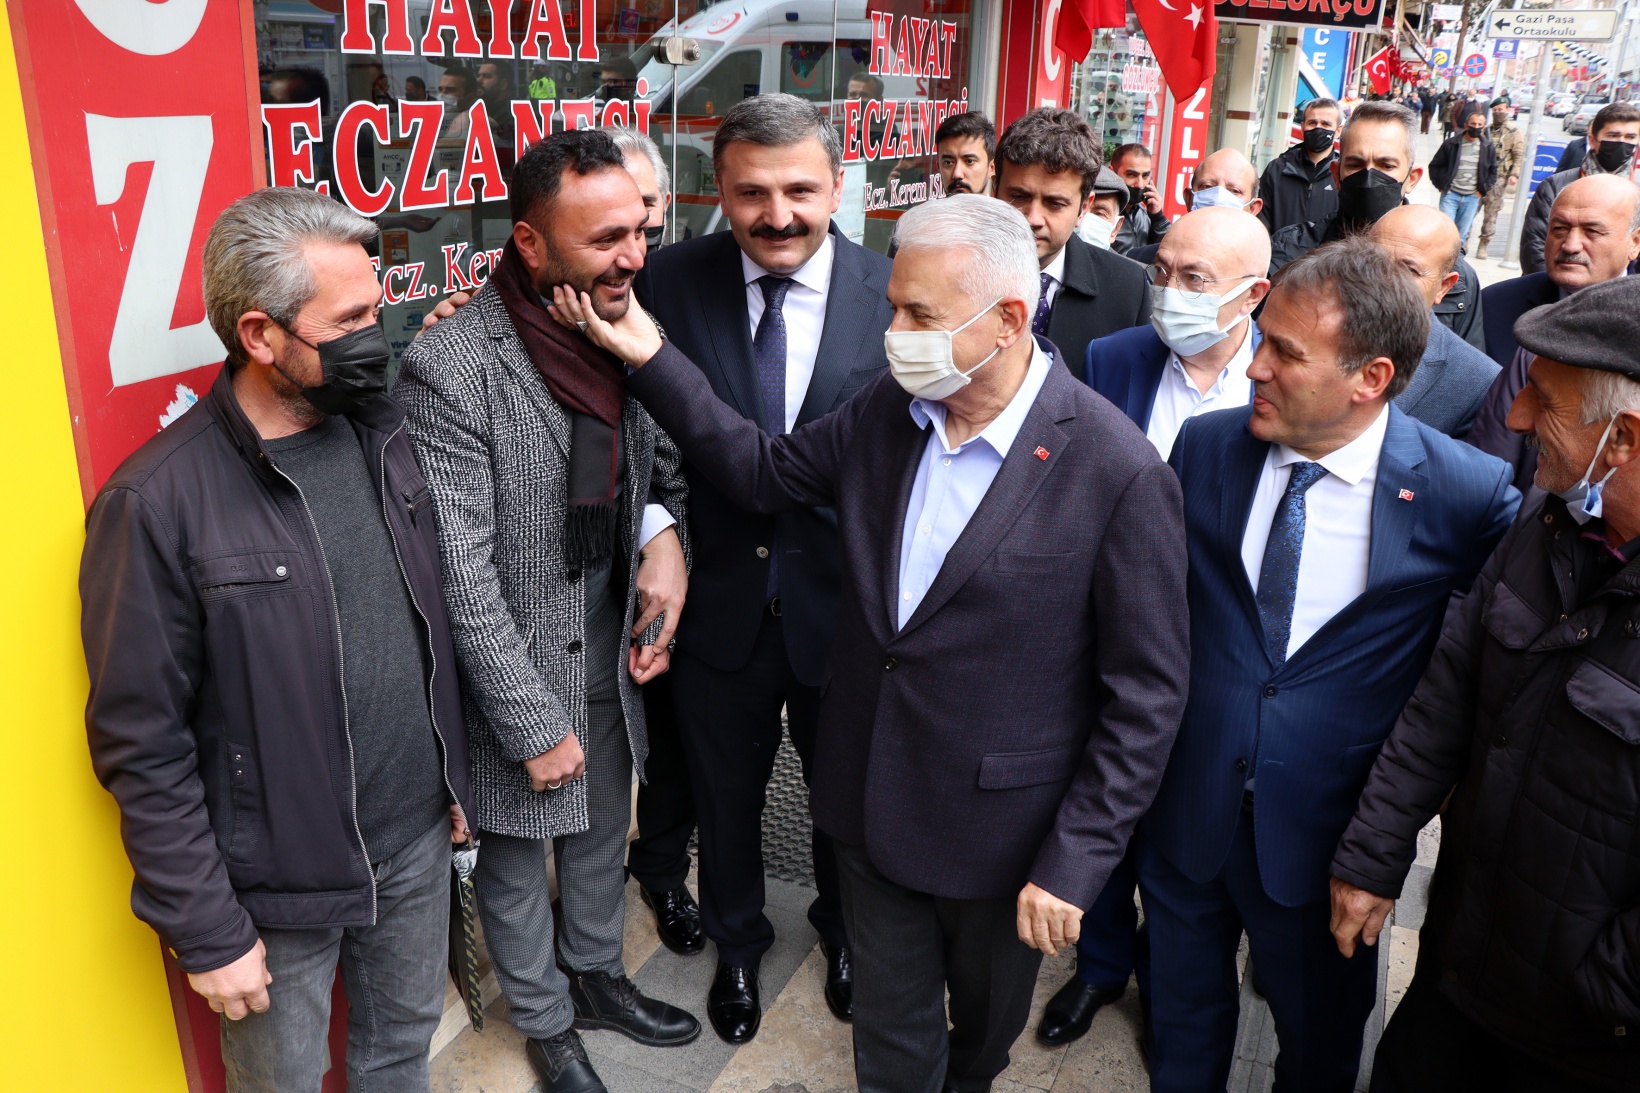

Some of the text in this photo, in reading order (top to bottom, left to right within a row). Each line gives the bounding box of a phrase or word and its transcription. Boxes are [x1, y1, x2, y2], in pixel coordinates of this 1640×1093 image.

[1513, 26, 1577, 36] Ortaokulu
[1516, 14, 1574, 25] Gazi Paşa
[869, 10, 957, 79] HAYAT
[842, 86, 969, 163] ECZANE
[863, 182, 889, 212] Ecz.
[890, 178, 927, 207] Kerem
